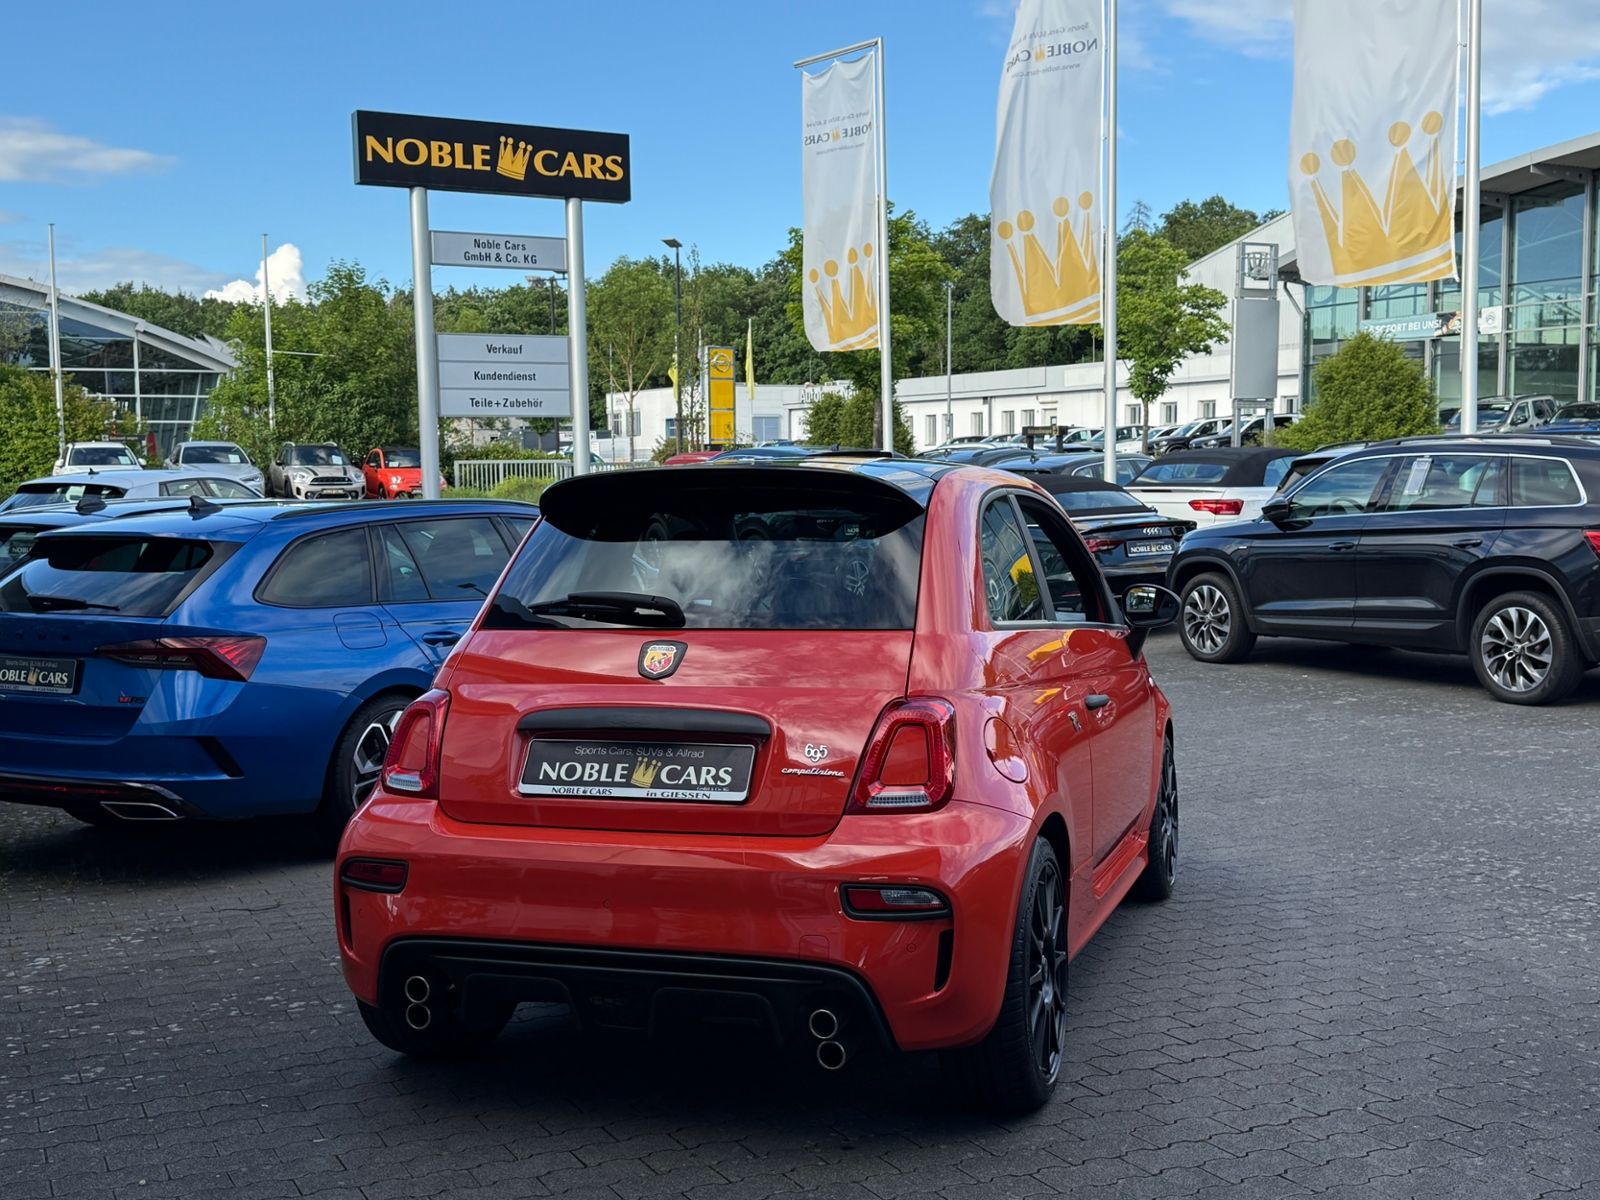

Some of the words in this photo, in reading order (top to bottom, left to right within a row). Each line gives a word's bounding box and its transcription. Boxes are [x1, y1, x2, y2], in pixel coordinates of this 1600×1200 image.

[365, 135, 491, 171] NOBLE
[533, 150, 624, 181] CARS
[473, 238, 501, 250] Noble
[504, 240, 527, 251] Cars
[464, 251, 491, 262] GmbH
[494, 252, 502, 263] &
[506, 253, 521, 264] Co.
[523, 254, 537, 264] KG
[1407, 321, 1421, 331] BEI
[1422, 319, 1442, 329] UNS!
[486, 343, 523, 354] Verkauf
[473, 370, 537, 381] Kundendienst
[1131, 545, 1151, 553] NOBLE
[0, 669, 28, 682] OBLE
[38, 671, 69, 685] CARS
[574, 745, 607, 756] Sports
[636, 747, 663, 757] SUVs
[665, 748, 673, 757] &
[675, 748, 705, 758] Allrad
[804, 743, 828, 762] 695
[538, 761, 629, 782] NOBLE
[660, 764, 733, 786] CARS
[551, 786, 580, 795] NOBLE
[589, 787, 613, 796] CARS
[660, 791, 712, 799] GIESSEN
